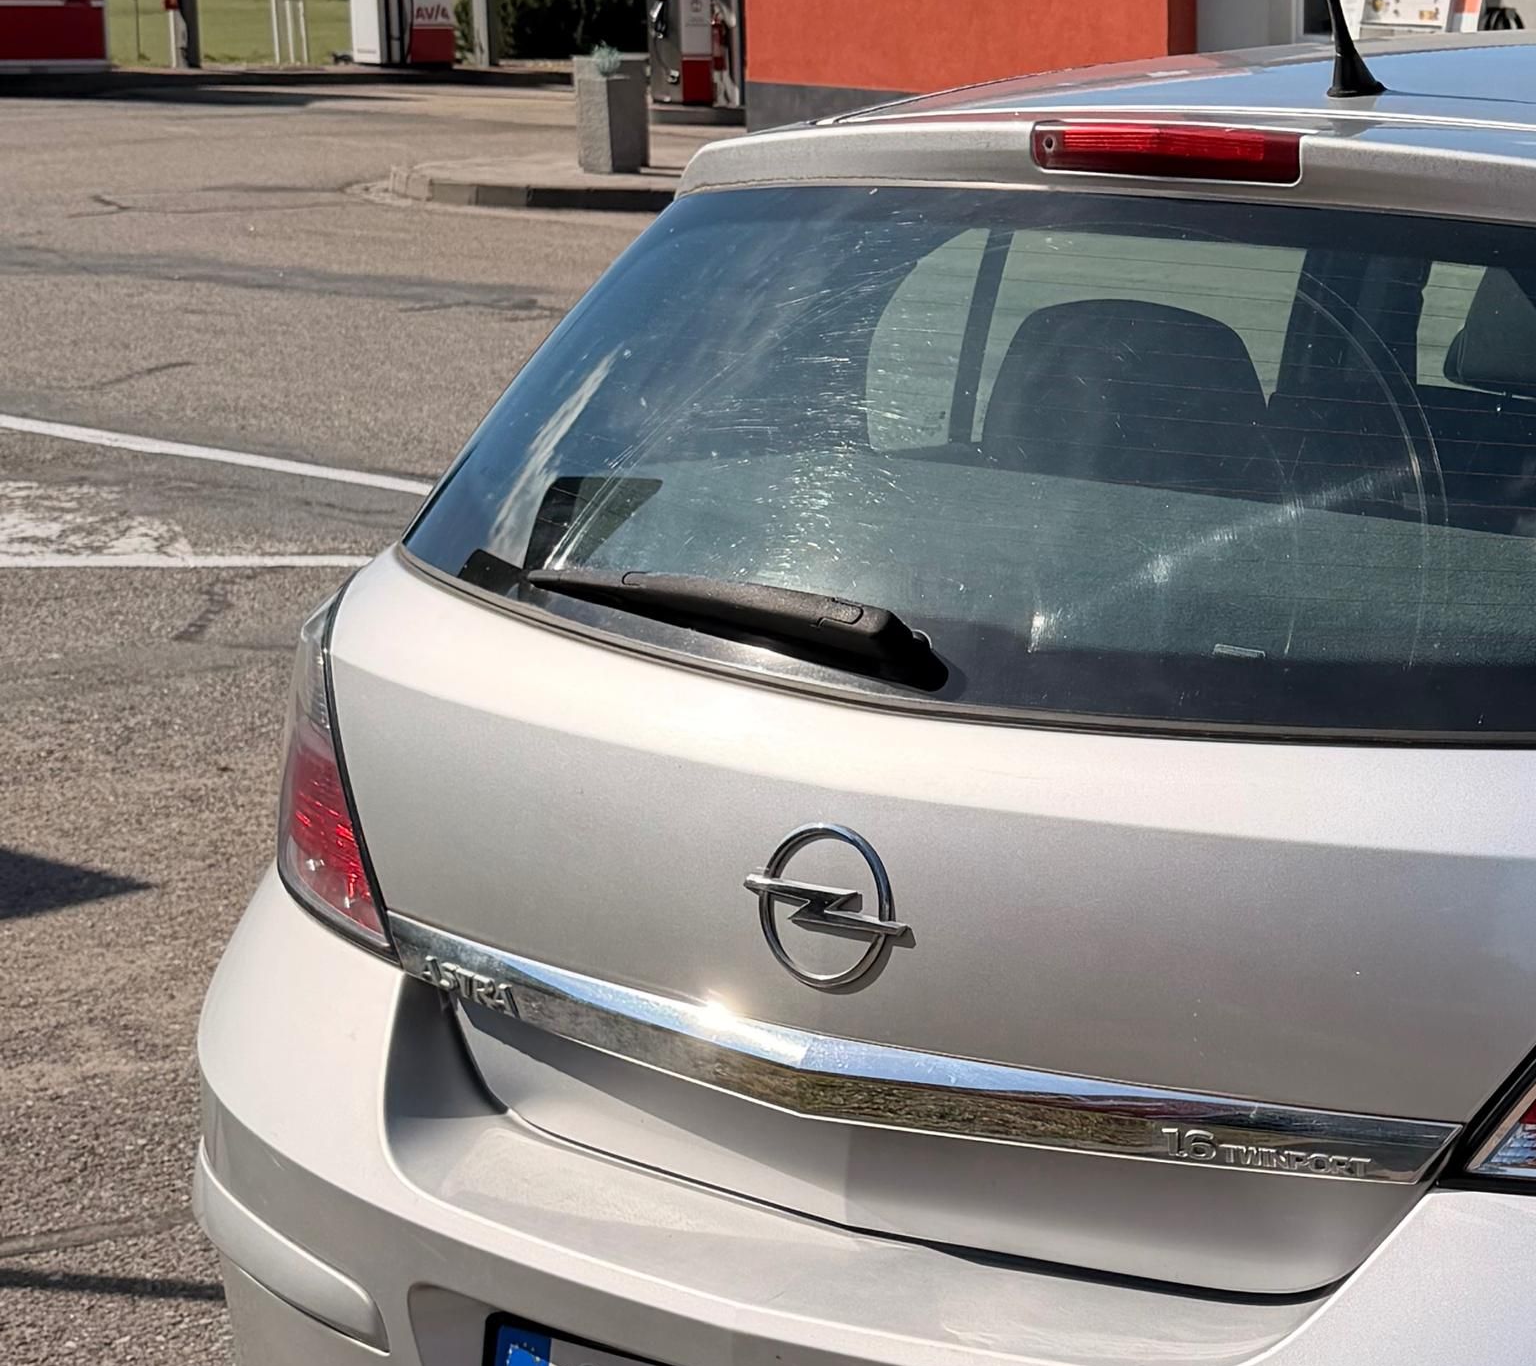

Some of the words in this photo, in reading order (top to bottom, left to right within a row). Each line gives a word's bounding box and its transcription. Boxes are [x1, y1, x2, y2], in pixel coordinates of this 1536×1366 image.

[422, 955, 521, 1019] ASTRA
[1161, 1127, 1217, 1161] 1.6
[1219, 1144, 1372, 1177] TWINPORT
